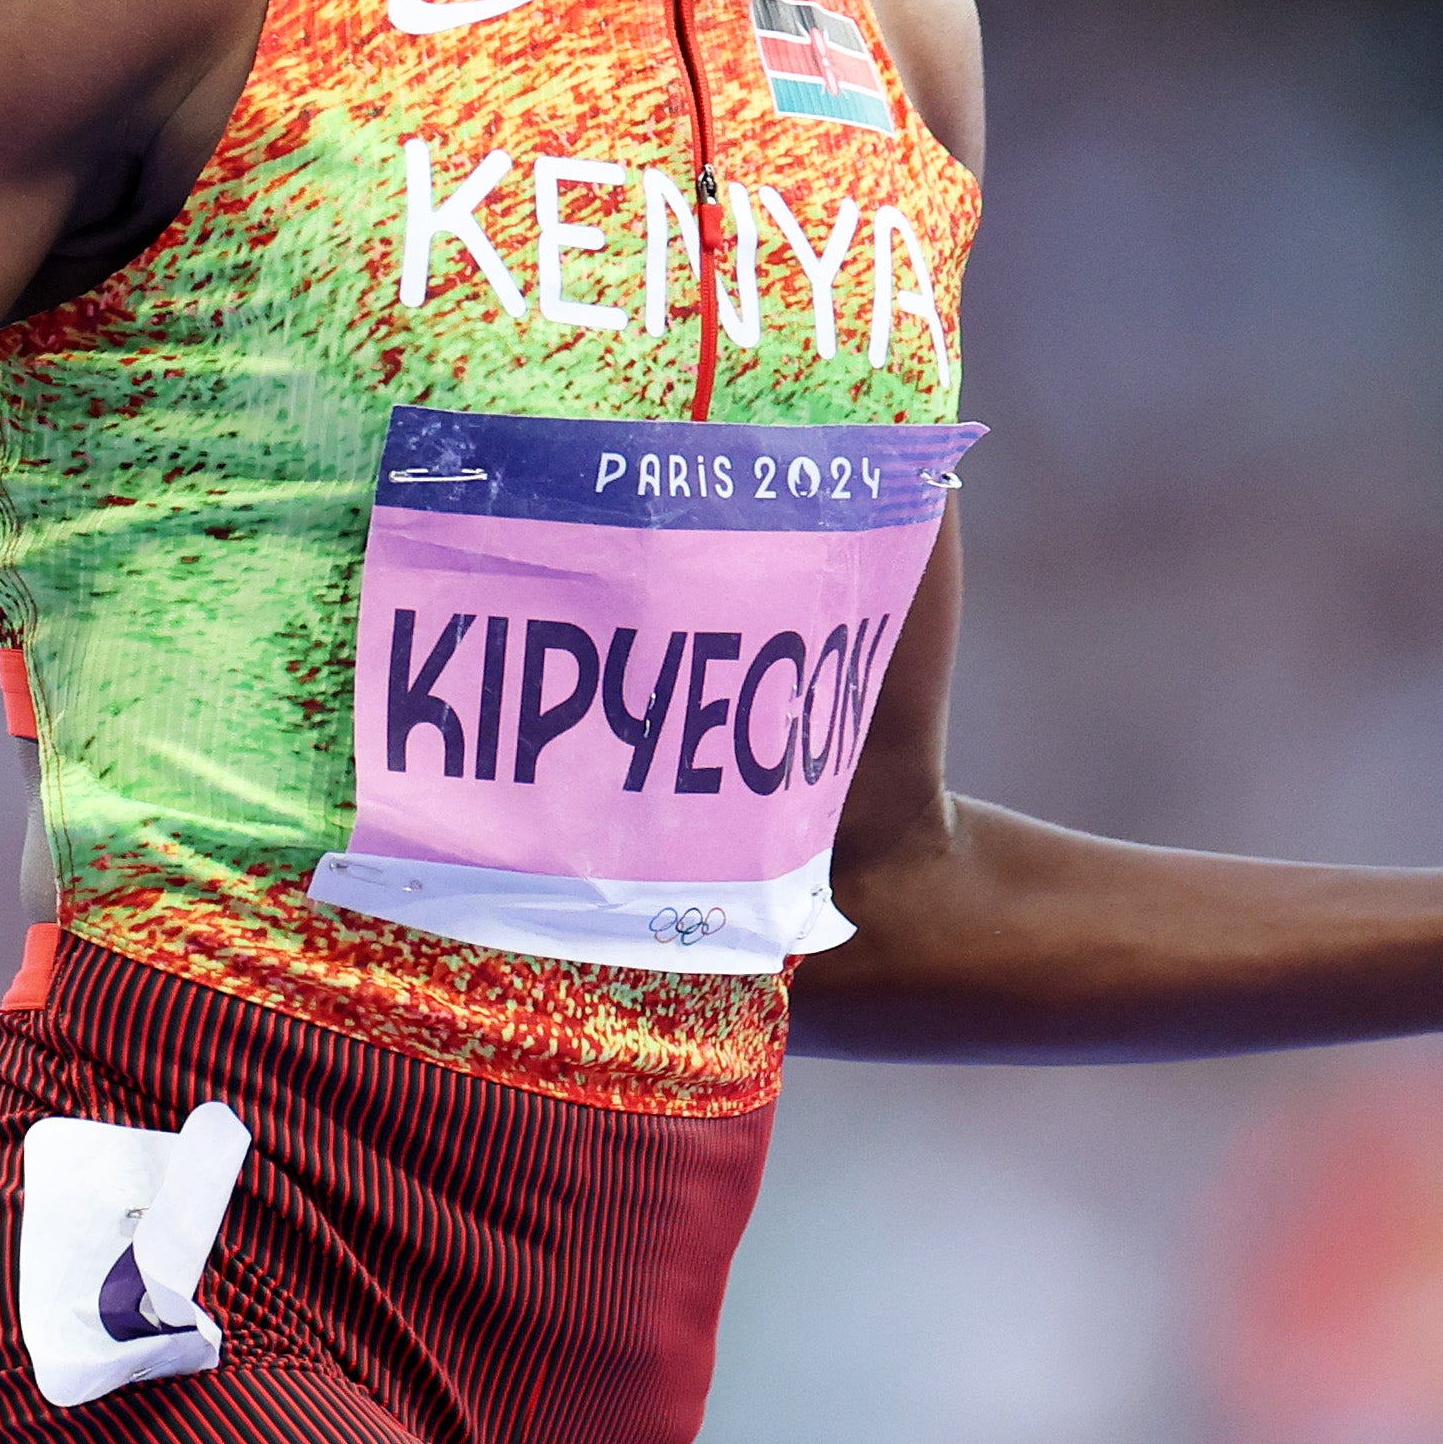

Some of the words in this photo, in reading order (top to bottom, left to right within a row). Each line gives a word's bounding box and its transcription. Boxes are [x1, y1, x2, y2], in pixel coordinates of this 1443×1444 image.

[398, 138, 951, 388] KENYA
[753, 456, 881, 500] 2024
[385, 607, 891, 796] KIPYEGON
